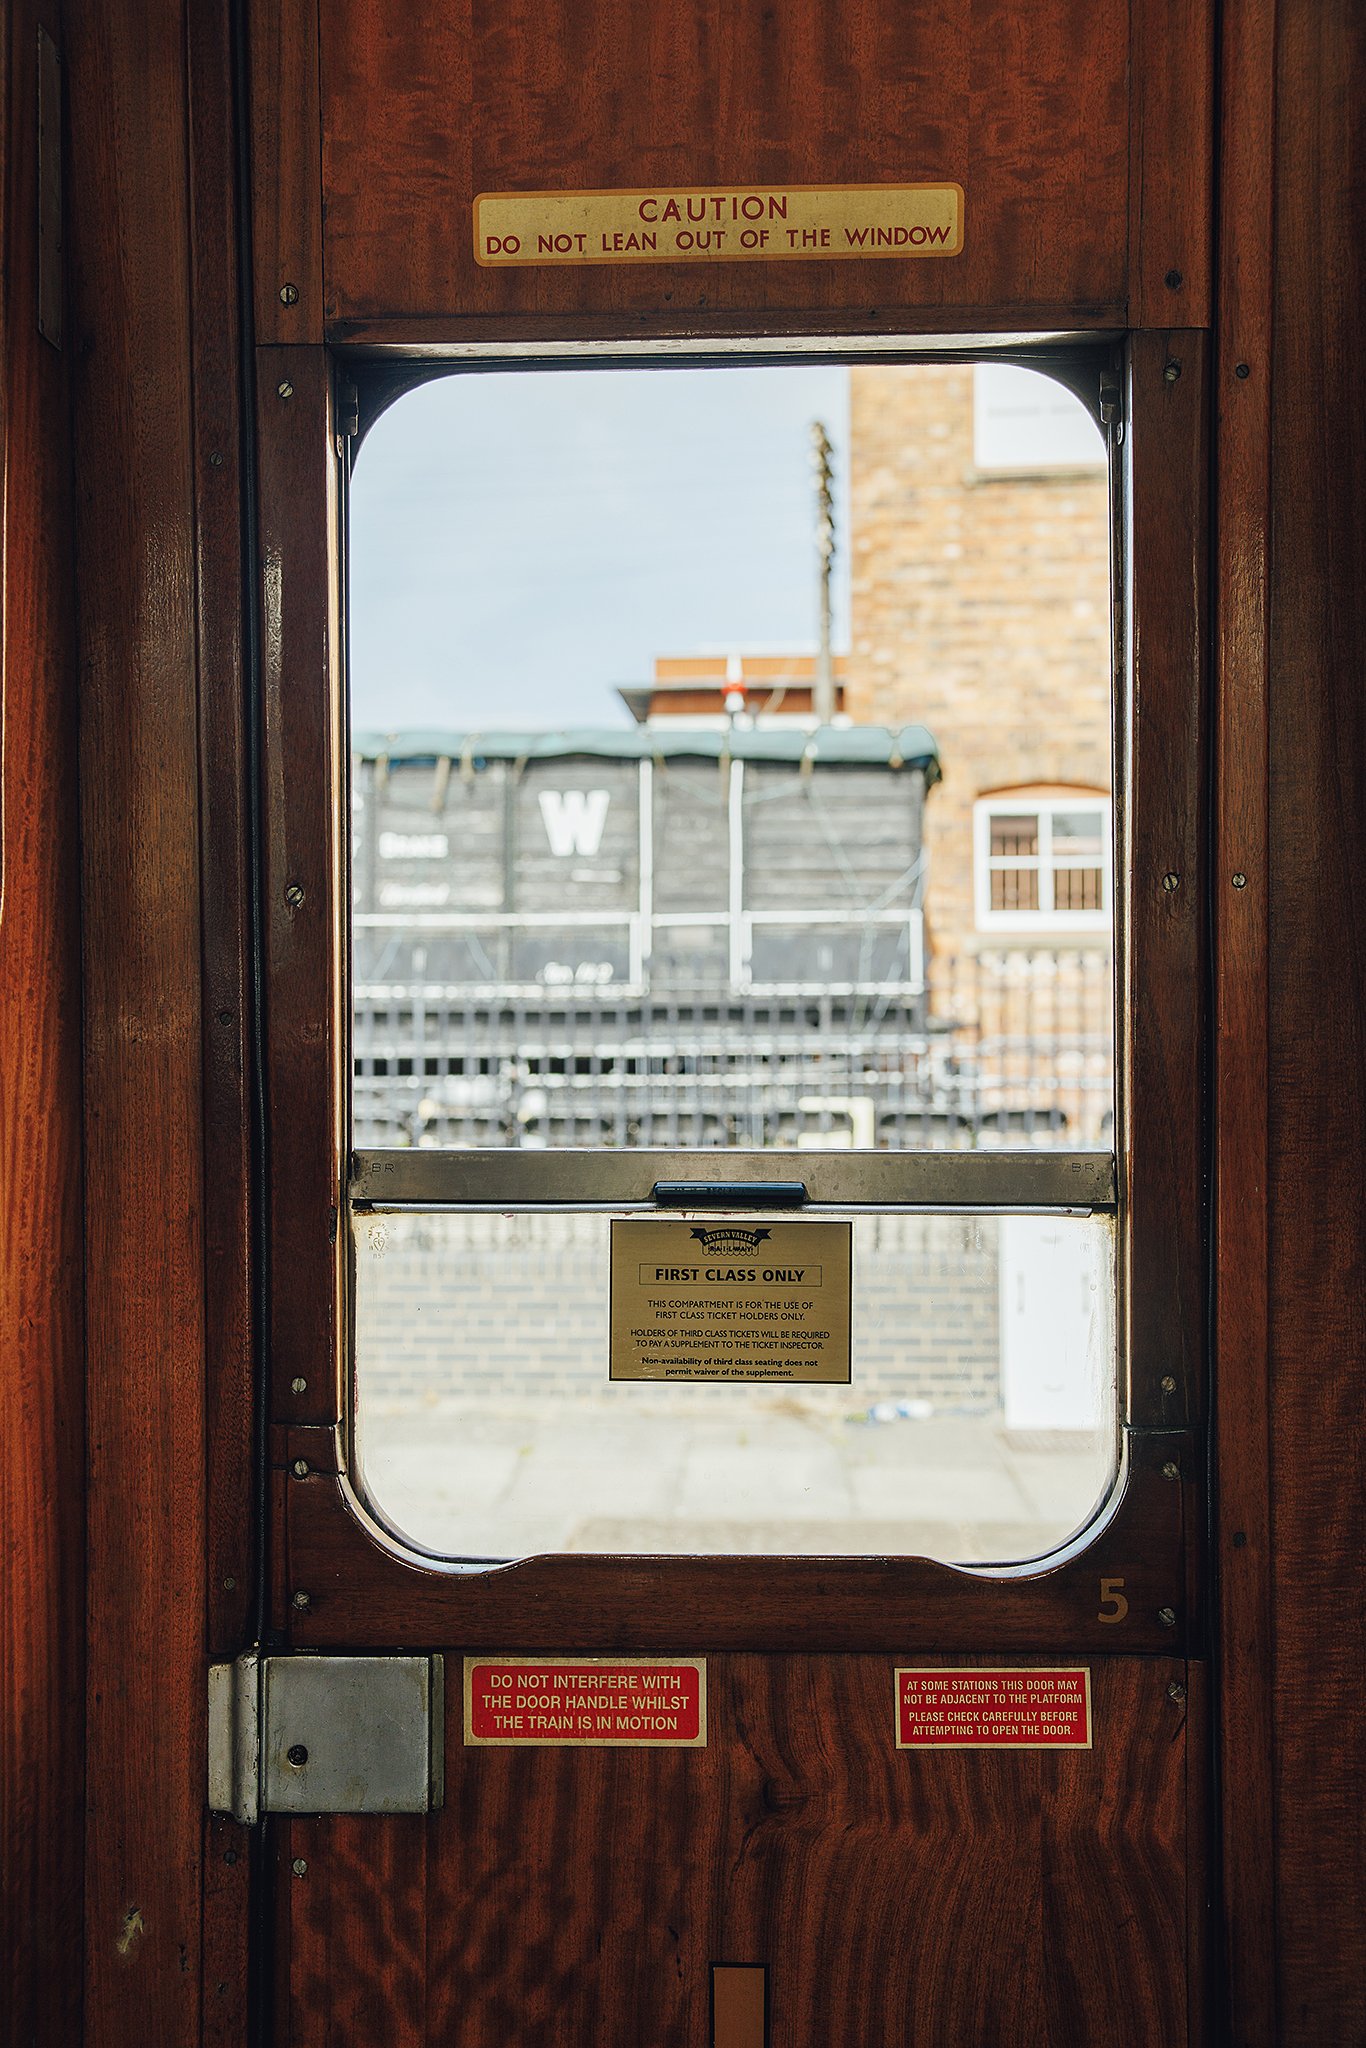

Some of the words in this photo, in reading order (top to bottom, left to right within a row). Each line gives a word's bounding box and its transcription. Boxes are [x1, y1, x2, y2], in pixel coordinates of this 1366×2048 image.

[639, 196, 787, 223] CAUTION
[486, 236, 521, 255] DO
[538, 234, 587, 253] NOT
[602, 231, 657, 252] LEAN
[675, 231, 726, 250] OUT
[739, 230, 770, 249] OF
[787, 229, 830, 248] THE
[844, 226, 951, 246] WINDOW
[538, 790, 610, 856] W
[704, 1232, 730, 1242] SEVERN
[732, 1232, 757, 1242] VALLEY
[655, 1269, 700, 1281] FIRST
[705, 1269, 756, 1281] CLASS
[762, 1270, 805, 1282] ONLY
[648, 1300, 667, 1308] THIS
[669, 1301, 734, 1309] COMPARTMENT
[736, 1301, 743, 1309] IS
[746, 1301, 762, 1309] FOR
[656, 1311, 677, 1319] FIRST
[739, 1312, 778, 1320] HOLDERS
[630, 1329, 666, 1337] HOLDERS
[667, 1329, 678, 1337] OF
[729, 1330, 759, 1338] TICKETS
[761, 1330, 779, 1338] WILL
[792, 1331, 830, 1340] REQUIRED
[671, 1340, 719, 1348] SUPPLEMENT
[752, 1341, 778, 1349] TICKET
[780, 1341, 824, 1350] INSPECTOR.
[642, 1357, 702, 1366] Non-availability
[713, 1358, 733, 1366] third
[735, 1358, 753, 1366] class
[755, 1359, 782, 1367] seating
[665, 1368, 692, 1376] permit
[721, 1368, 729, 1376] of
[731, 1368, 744, 1376] the
[746, 1368, 793, 1377] supplement.
[1097, 1578, 1129, 1624] 5
[490, 1675, 512, 1688] DO
[517, 1675, 549, 1688] NOT
[554, 1675, 637, 1689] INTERFERE
[642, 1676, 680, 1689] WITH
[907, 1681, 918, 1690] AT
[921, 1681, 948, 1690] SOME
[952, 1681, 998, 1690] STATIONS
[1001, 1681, 1023, 1690] THIS
[1026, 1681, 1054, 1690] DOOR
[1057, 1680, 1078, 1690] MAY
[482, 1695, 511, 1708] THE
[516, 1695, 561, 1709] DOOR
[566, 1696, 627, 1709] HANDLE
[632, 1697, 689, 1709] WHILST
[904, 1695, 923, 1704] NOT
[926, 1695, 938, 1704] BE
[940, 1694, 991, 1704] ADJACENT
[993, 1694, 1006, 1704] TO
[1009, 1694, 1027, 1704] THE
[1030, 1694, 1082, 1704] PLATFORM
[909, 1712, 944, 1722] PLEASE
[947, 1712, 980, 1722] CHECK
[982, 1712, 1037, 1722] CAREFULLY
[1040, 1712, 1078, 1722] BEFORE
[494, 1716, 523, 1729] THE
[528, 1716, 573, 1729] TRAIN
[578, 1716, 592, 1729] IS
[597, 1717, 612, 1729] IN
[616, 1717, 677, 1730] MOTION
[913, 1726, 974, 1735] ATTEMPTING
[976, 1725, 989, 1735] TO
[992, 1725, 1018, 1735] OPEN
[1021, 1725, 1039, 1735] THE
[1043, 1725, 1074, 1735] DOOR.
